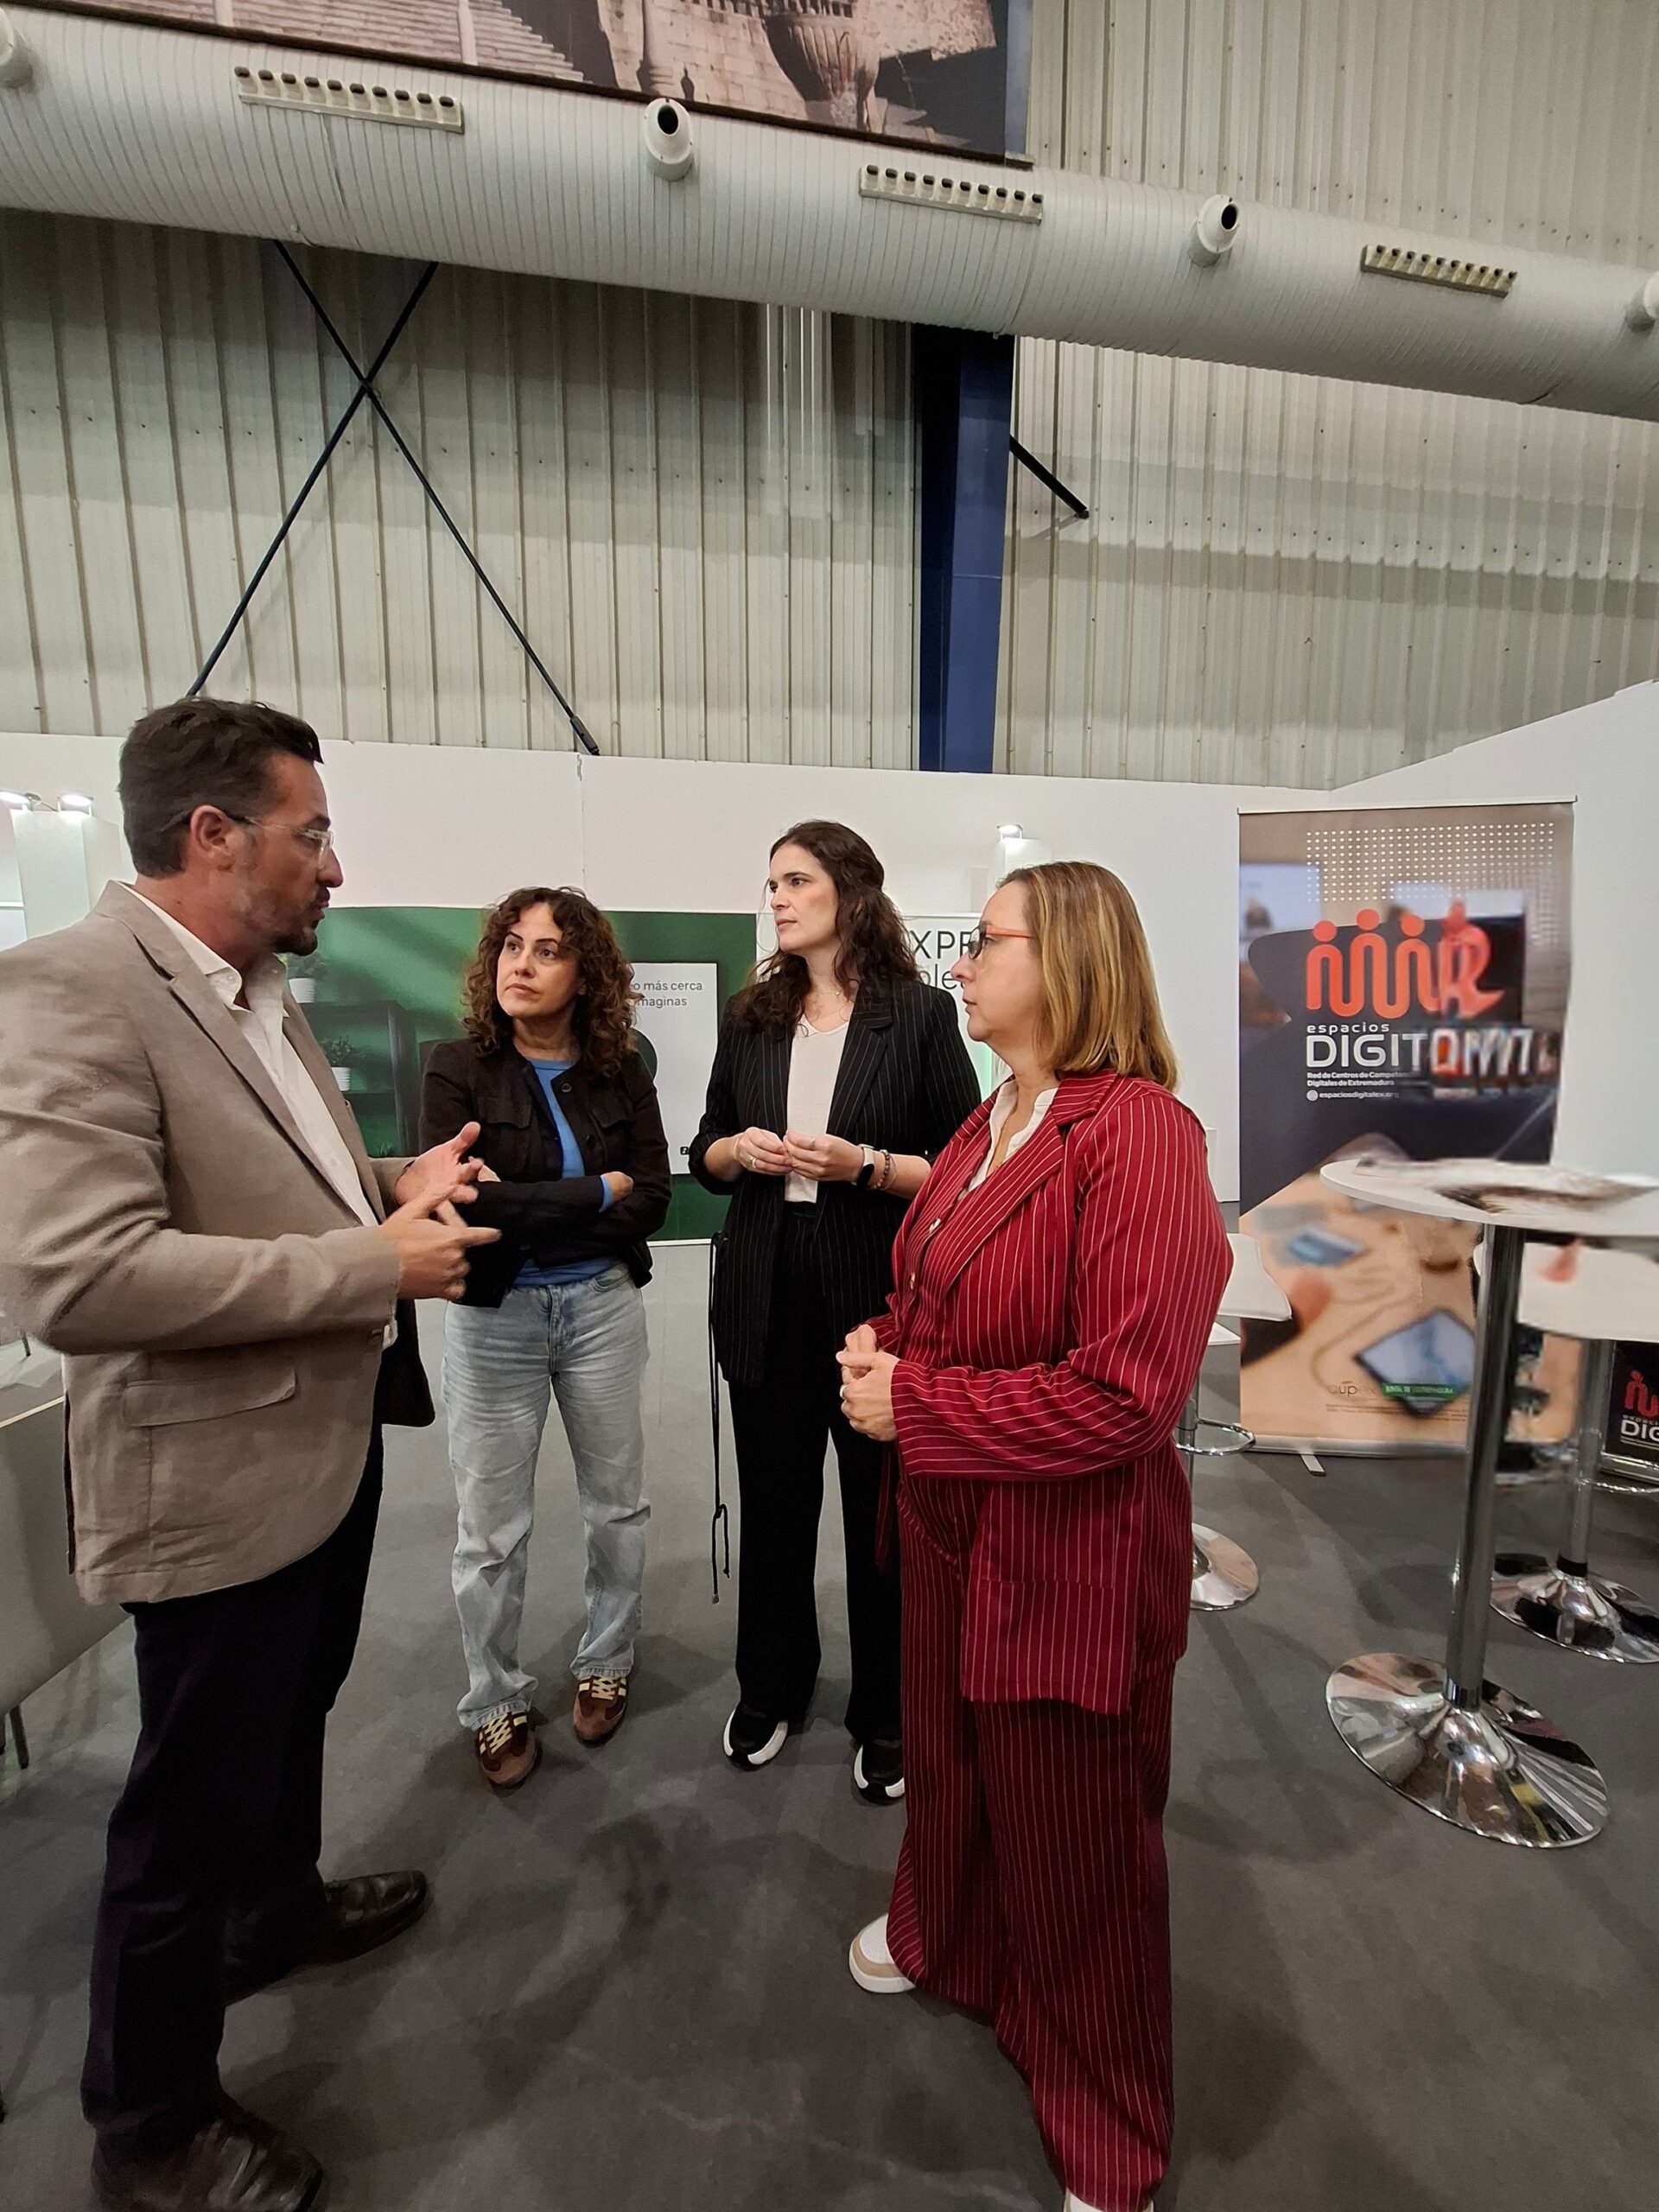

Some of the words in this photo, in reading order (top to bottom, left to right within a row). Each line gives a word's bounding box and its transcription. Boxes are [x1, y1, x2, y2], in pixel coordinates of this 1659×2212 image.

[643, 980, 669, 990] más
[671, 982, 702, 991] cerca
[637, 996, 688, 1009] maginas
[1306, 1022, 1389, 1035] espacios
[1306, 1079, 1338, 1088] Digitales
